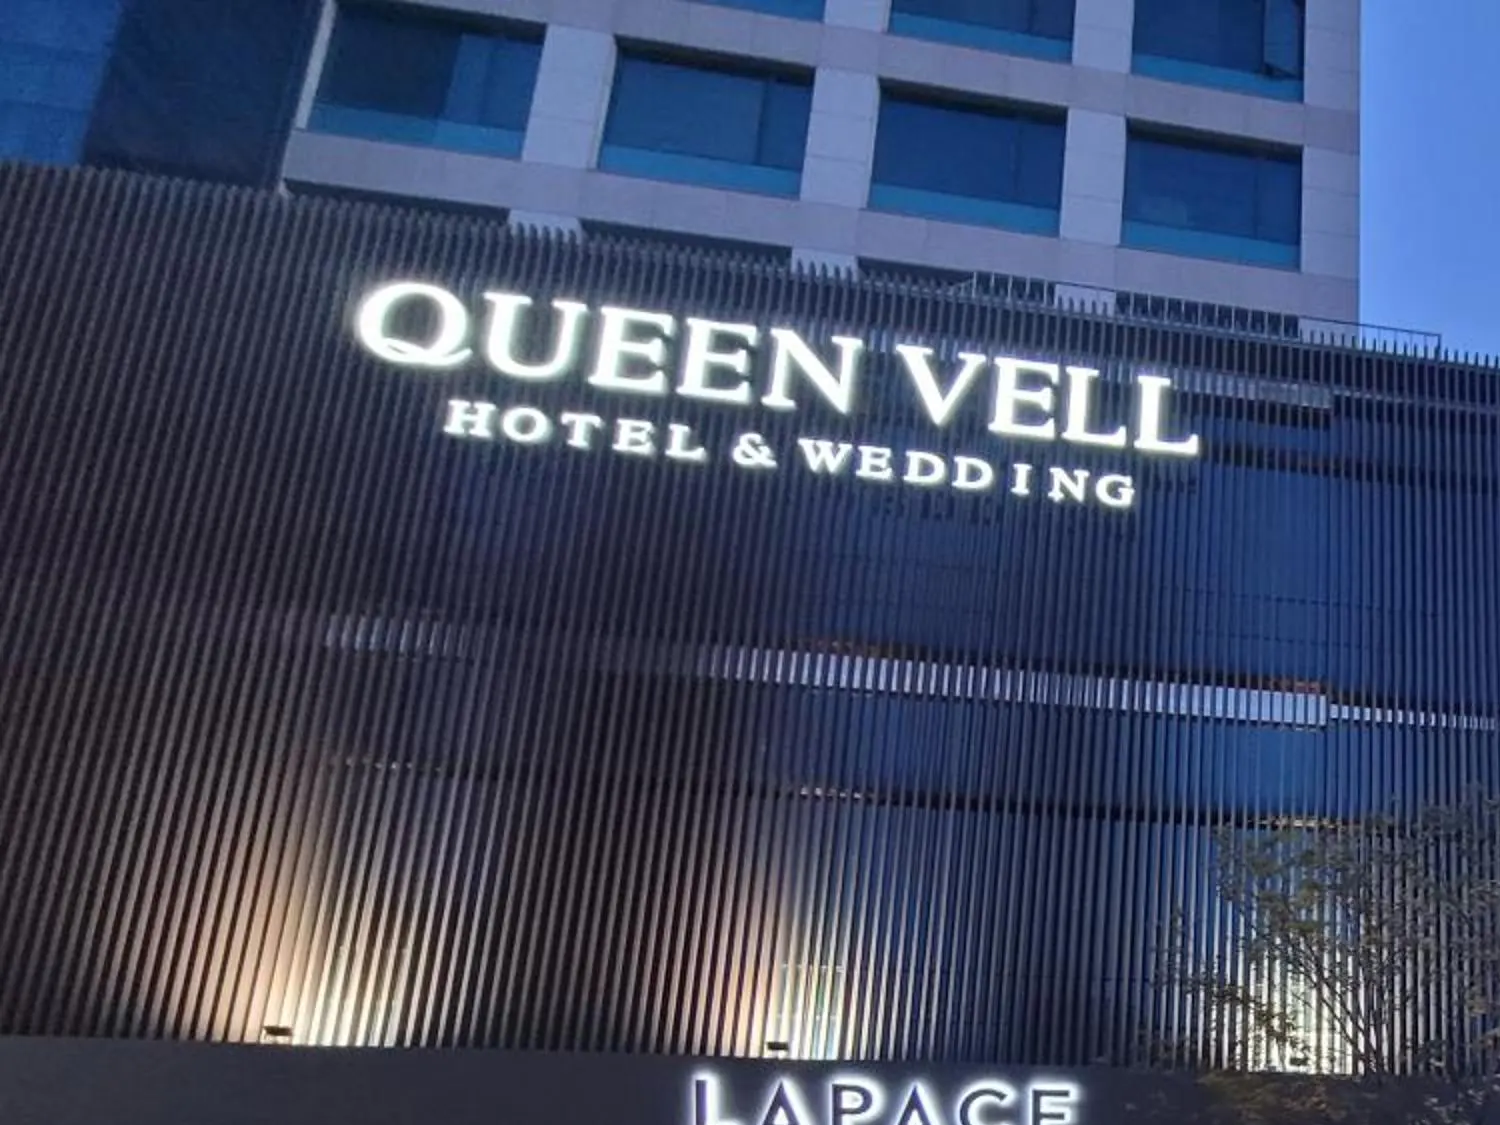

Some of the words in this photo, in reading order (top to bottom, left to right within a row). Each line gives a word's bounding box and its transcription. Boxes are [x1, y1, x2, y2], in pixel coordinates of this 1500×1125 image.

[355, 280, 864, 415] QUEEN
[894, 342, 1200, 456] VELL
[443, 398, 706, 461] HOTEL
[731, 431, 778, 468] &
[797, 437, 1136, 508] WEDDING
